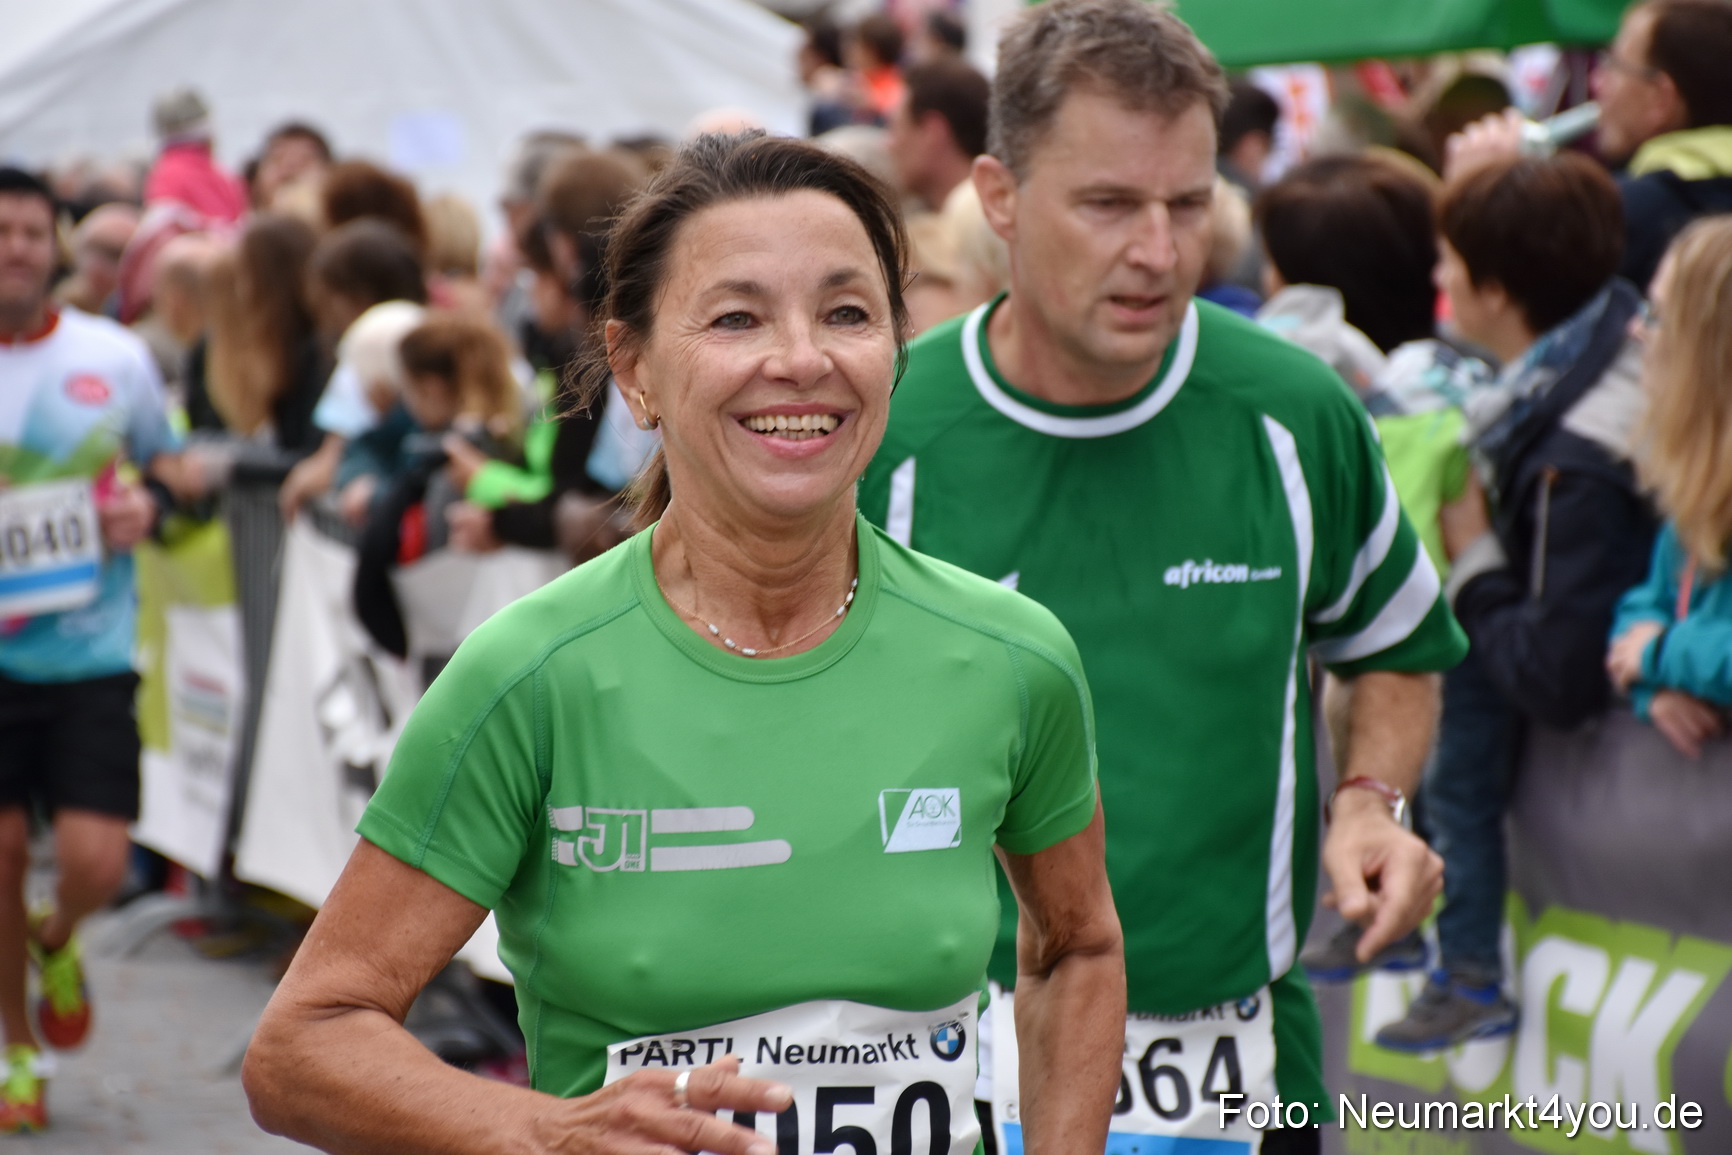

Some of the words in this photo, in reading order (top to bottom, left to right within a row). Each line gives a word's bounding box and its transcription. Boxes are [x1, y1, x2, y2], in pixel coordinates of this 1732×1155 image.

[1162, 557, 1249, 588] africon
[907, 793, 957, 820] AOK
[756, 1032, 921, 1065] Neumarkt
